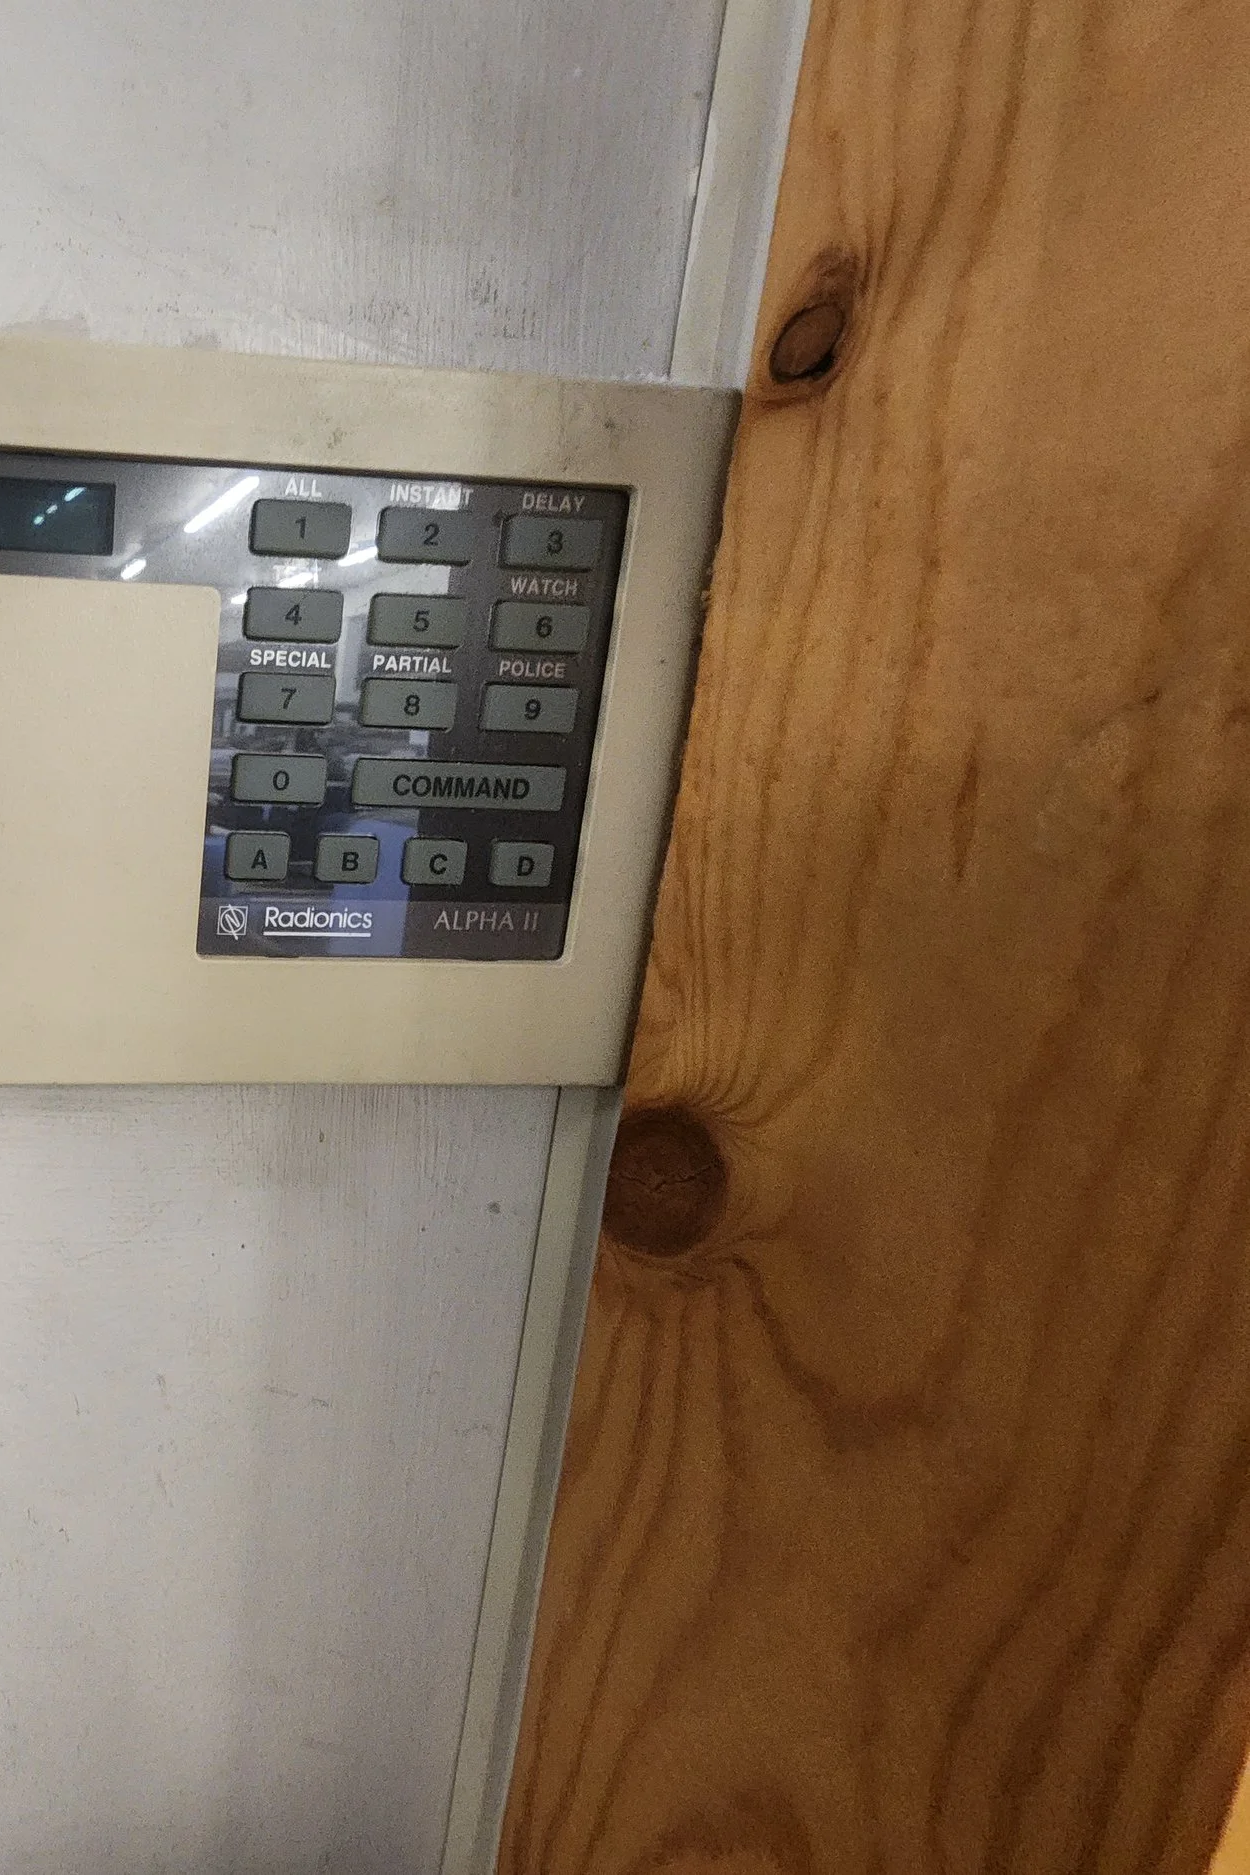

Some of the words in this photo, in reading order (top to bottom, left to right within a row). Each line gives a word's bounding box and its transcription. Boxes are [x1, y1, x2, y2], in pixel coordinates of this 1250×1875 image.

[284, 479, 322, 498] ALL
[389, 483, 474, 505] INSTANT
[522, 492, 586, 513] DELAY
[294, 515, 308, 539] 1
[423, 523, 440, 547] 2
[548, 530, 564, 555] 3
[510, 578, 579, 597] WATCH
[284, 605, 303, 627] 4
[412, 609, 430, 633] 5
[535, 617, 553, 639] 6
[249, 649, 332, 670] SPECIAL
[372, 654, 452, 675] PARTIAL
[499, 659, 567, 679] POLICE
[280, 687, 298, 710] 7
[403, 694, 421, 716] 8
[524, 698, 542, 721] 9
[272, 769, 290, 791] 0
[392, 773, 530, 801] COMMAND
[250, 849, 269, 871] A
[341, 851, 360, 872] B
[429, 854, 449, 876] C
[517, 856, 535, 877] D
[264, 906, 373, 930] Radionics
[433, 910, 515, 932] ALPHA
[524, 911, 539, 931] II
